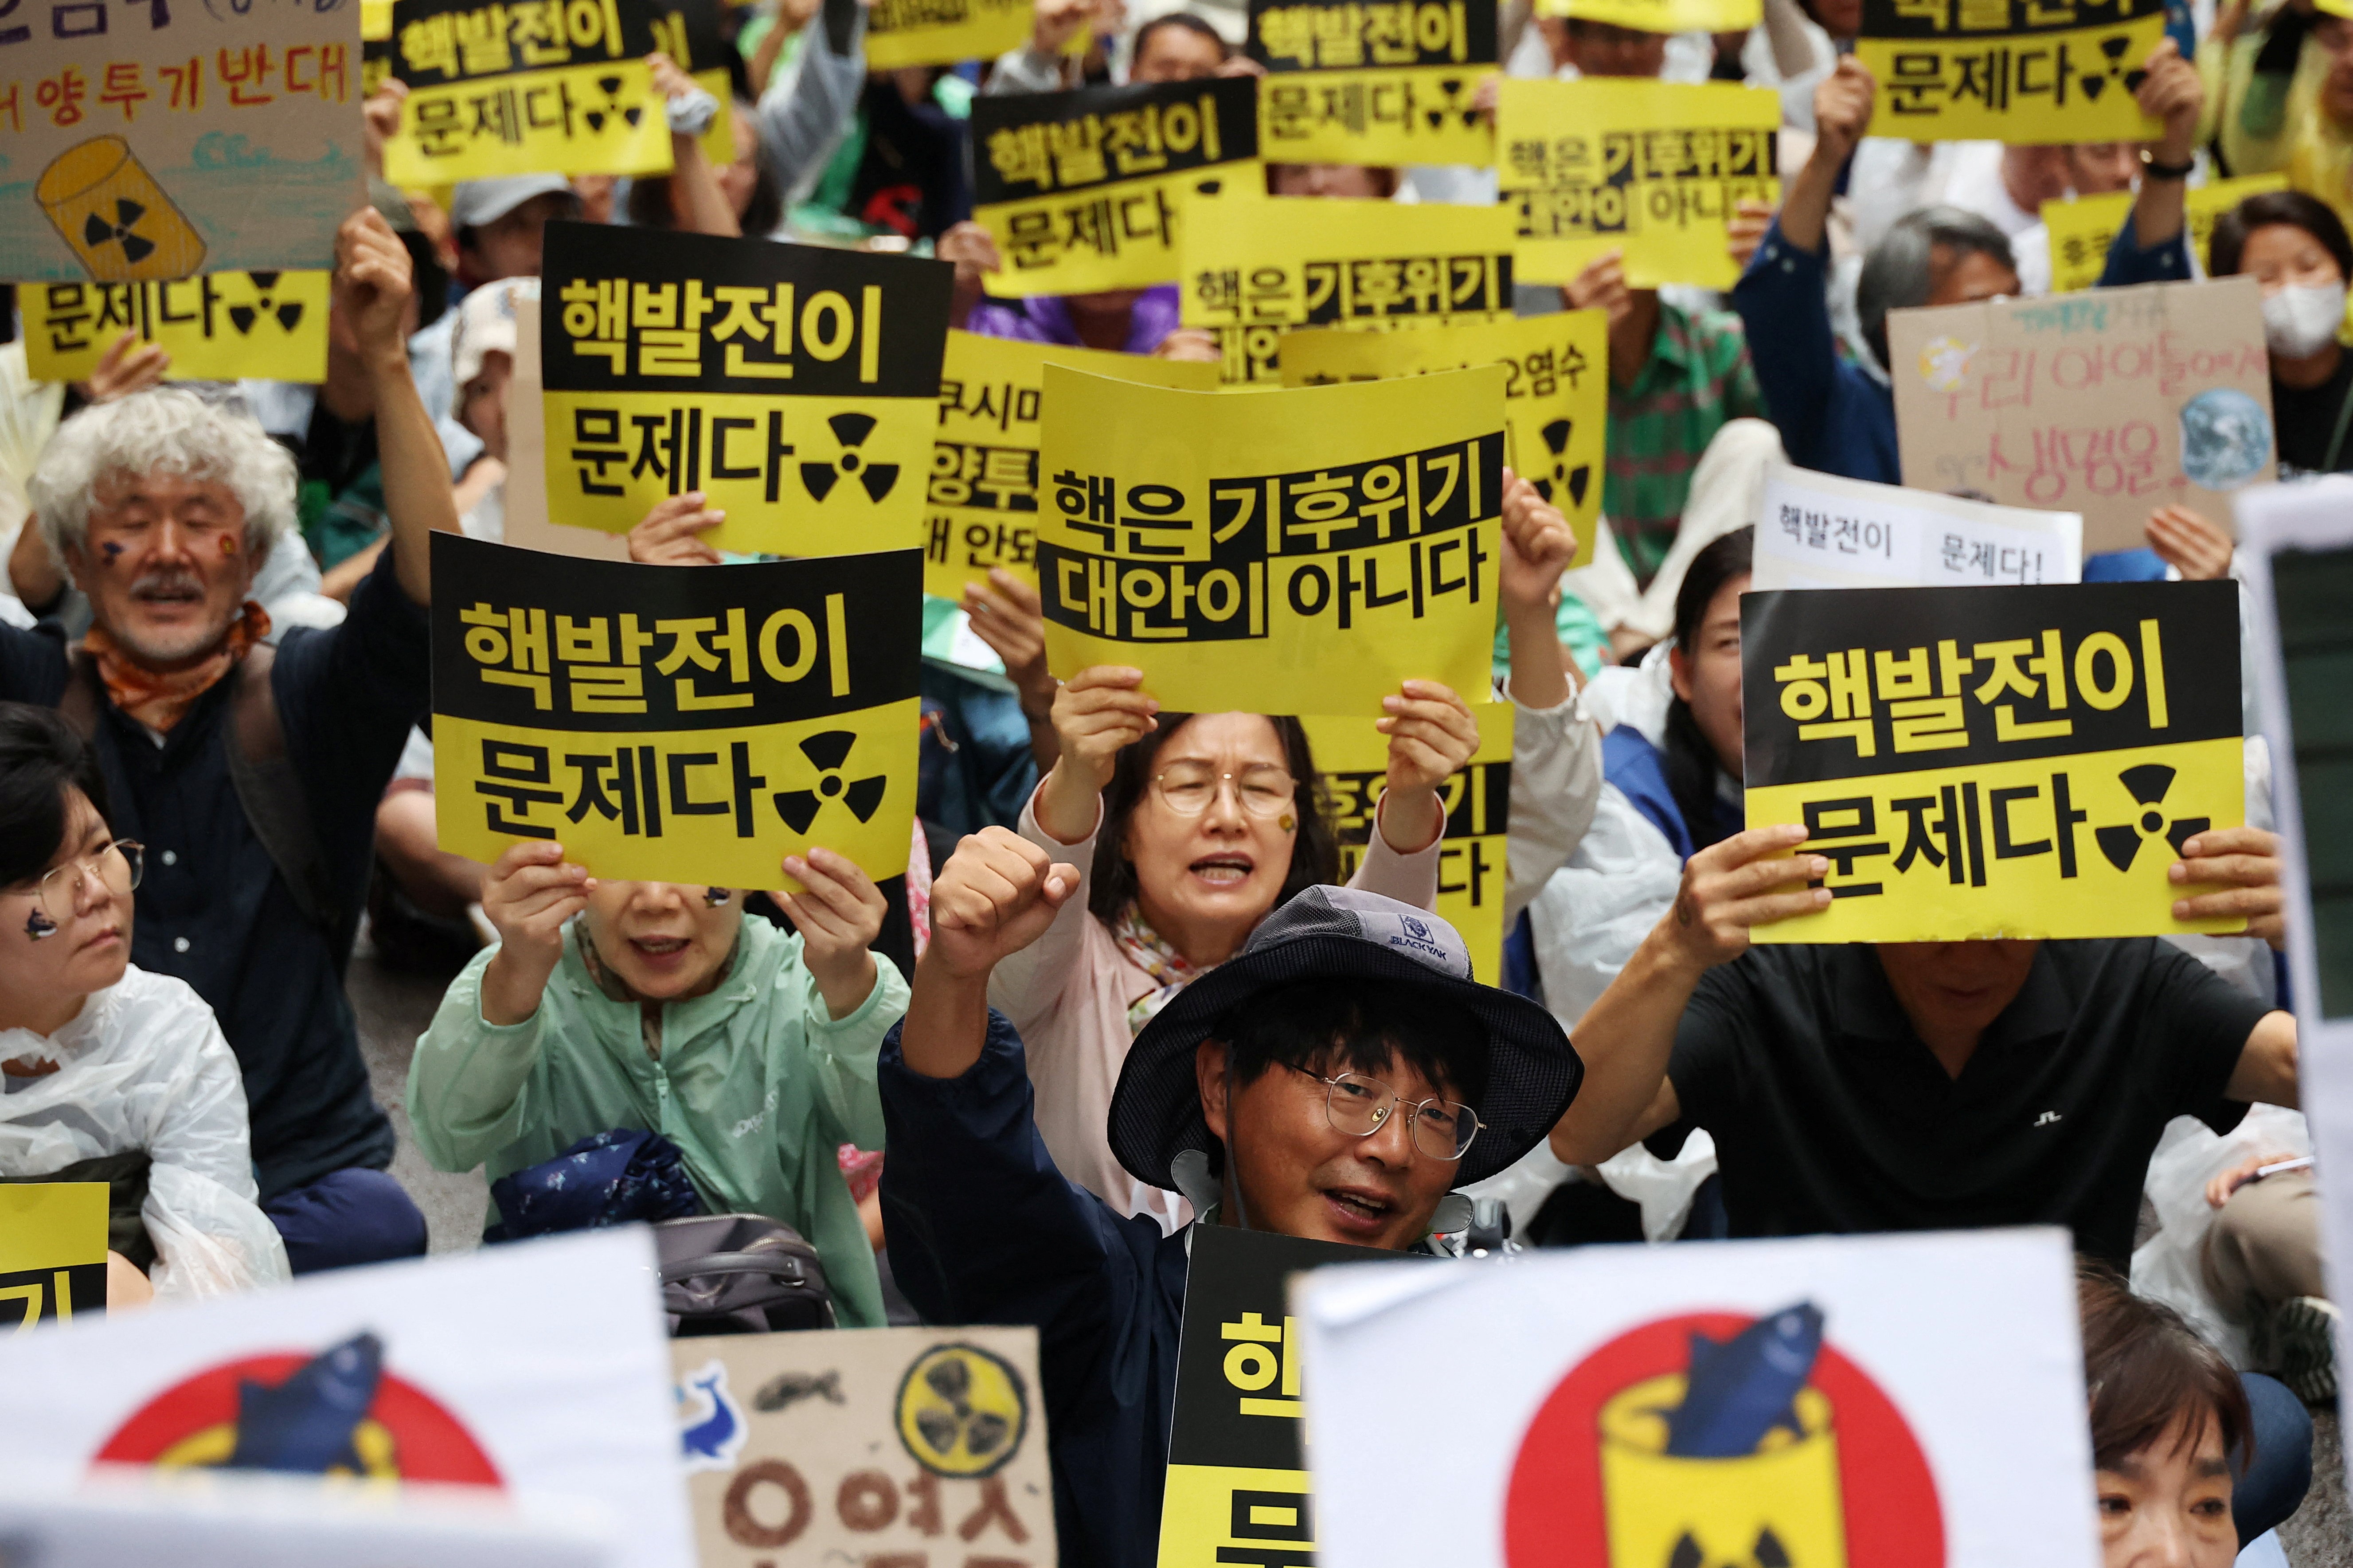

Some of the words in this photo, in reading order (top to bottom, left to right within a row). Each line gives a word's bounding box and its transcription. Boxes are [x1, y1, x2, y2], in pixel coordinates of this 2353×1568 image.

[399, 0, 624, 79] 핵발전이
[1258, 4, 1469, 67] 핵발전이
[415, 82, 578, 156] 문제다
[1270, 79, 1415, 141] 문제다
[1886, 43, 2075, 113] 문제다
[986, 93, 1221, 190] 핵발전이
[1007, 190, 1175, 269] 문제다
[45, 274, 223, 352] 문제다
[1196, 267, 1291, 318] 핵은
[1305, 257, 1501, 316] 기후위기
[560, 278, 882, 384] 핵발전이
[571, 407, 794, 503] 문제다
[1052, 470, 1193, 554] 핵은
[1212, 441, 1481, 554] 기후위기
[1057, 558, 1264, 640] 대안이
[1287, 527, 1488, 630] 아니다
[1778, 503, 1892, 558] 핵발전이
[1941, 533, 2043, 585] 문제다!
[460, 593, 850, 713] 핵발전이
[1774, 618, 2169, 757] 핵발전이
[475, 738, 766, 840] 문제다
[1794, 772, 2087, 900] 문제다
[1391, 935, 1447, 961] BLACKYAK
